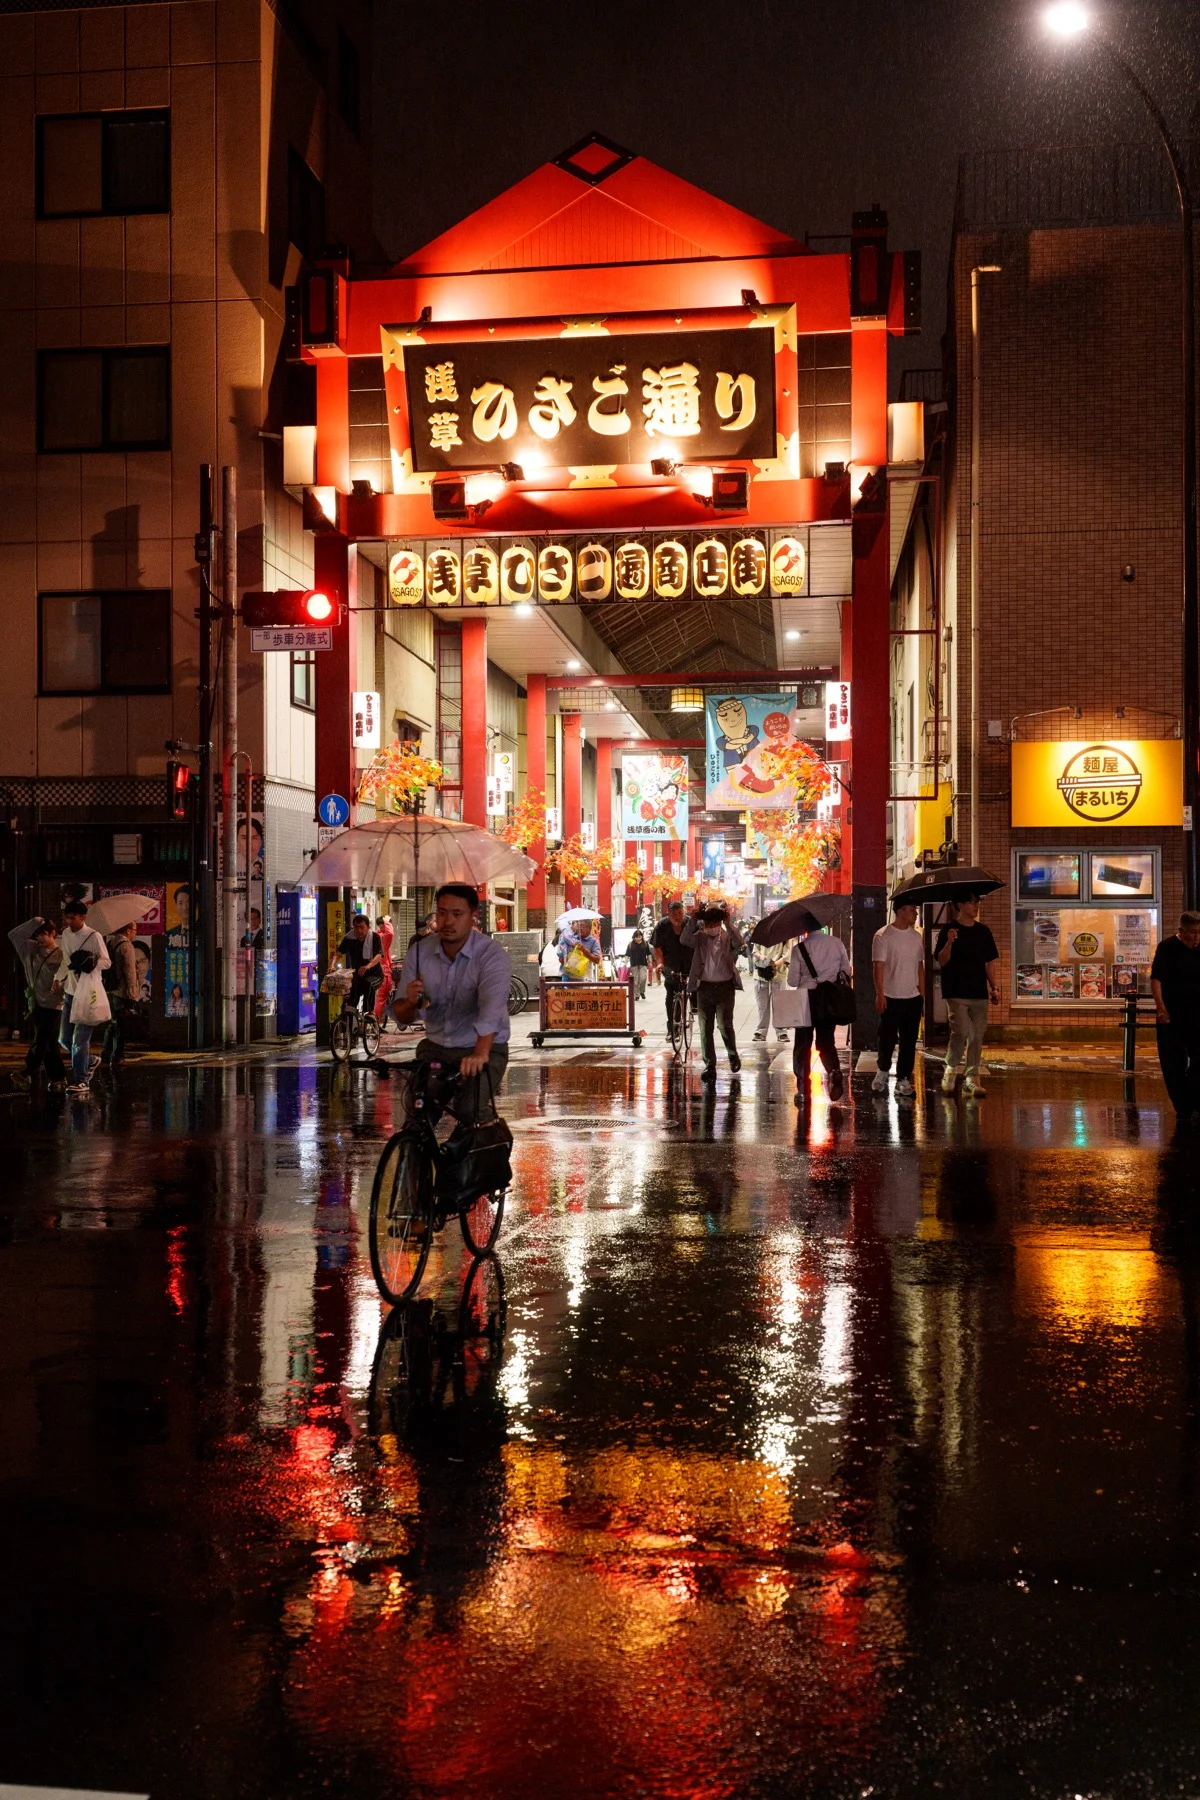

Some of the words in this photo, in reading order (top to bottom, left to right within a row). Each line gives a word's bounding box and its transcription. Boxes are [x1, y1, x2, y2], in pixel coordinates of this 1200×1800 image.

[425, 361, 462, 452] 浅草
[471, 361, 757, 442] ひさご通り
[255, 631, 270, 640] 一部
[273, 632, 328, 646] 歩車分離式
[840, 684, 849, 725] ひさご通り
[1083, 757, 1119, 773] 麺屋
[1075, 790, 1129, 806] まるいち
[564, 1000, 622, 1012] 車両通行止
